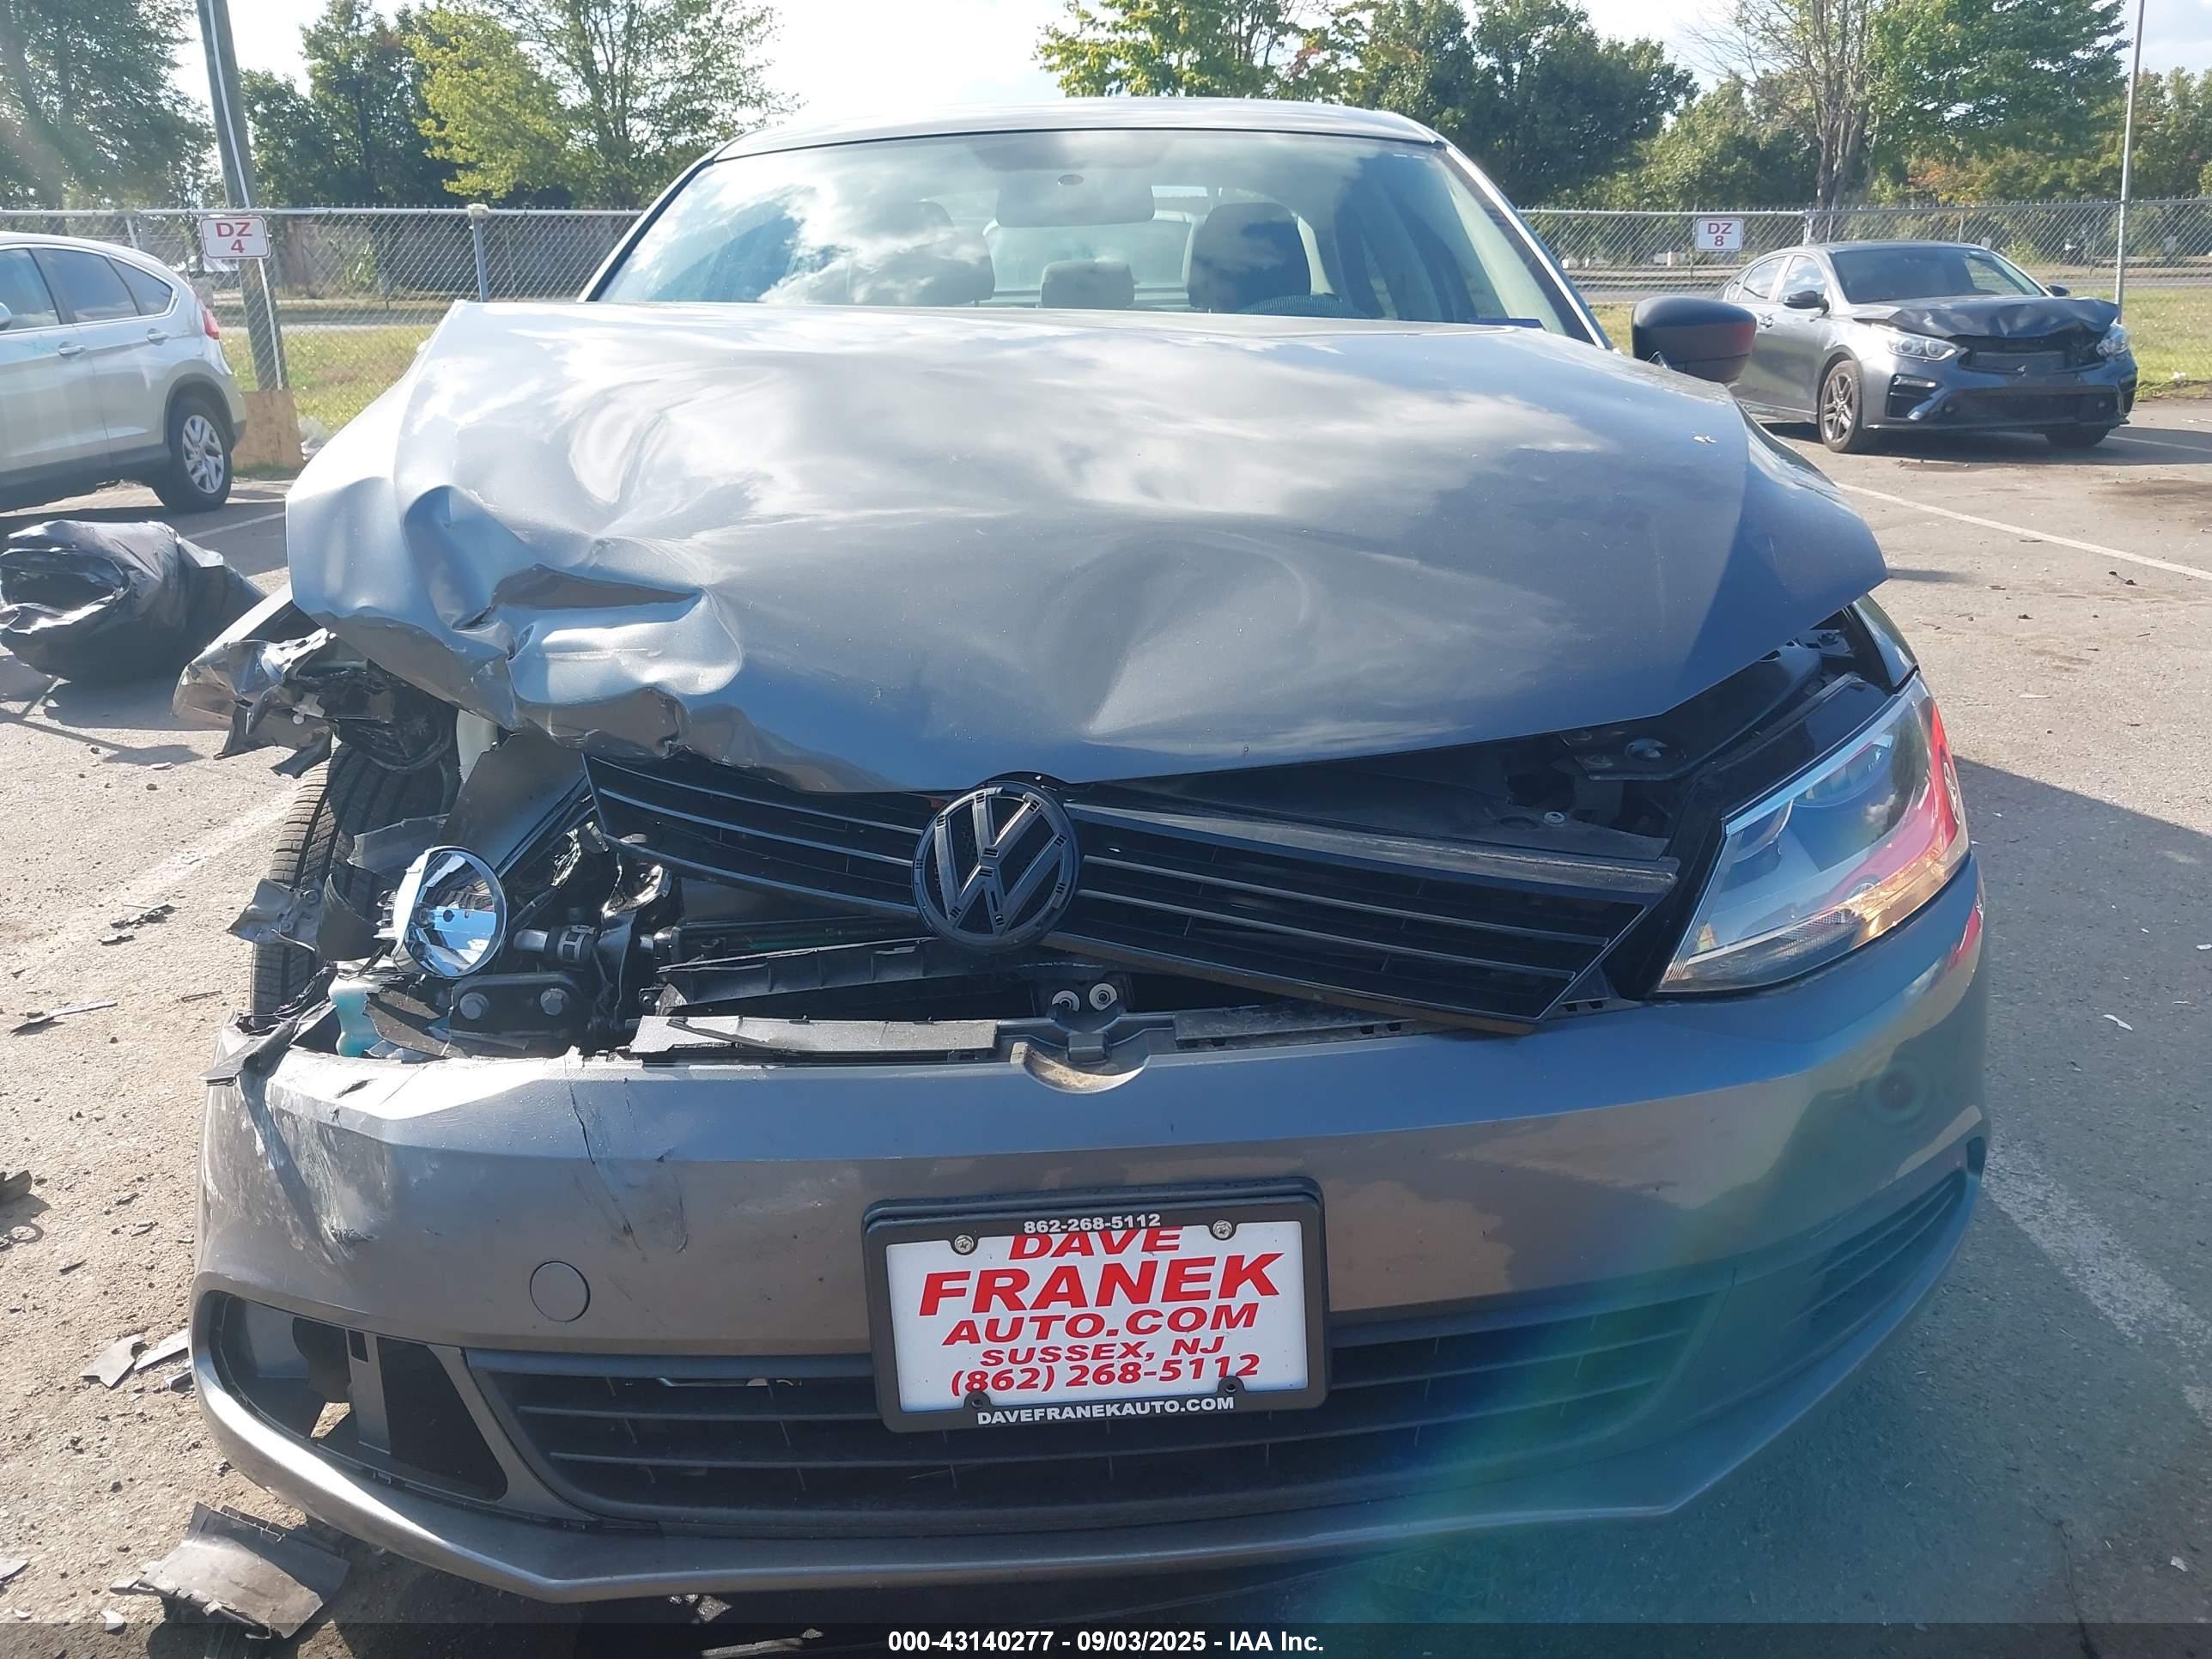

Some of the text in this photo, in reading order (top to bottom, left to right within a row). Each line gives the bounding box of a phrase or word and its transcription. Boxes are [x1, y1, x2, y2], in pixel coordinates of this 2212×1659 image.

[216, 222, 252, 237] DZ
[1707, 222, 1733, 234] DZ
[1714, 235, 1724, 246] 8
[230, 239, 245, 253] 4
[1024, 1212, 1161, 1234] 862-268-5112
[1008, 1225, 1183, 1261] DAVE
[919, 1252, 1285, 1316] FRANEK
[941, 1303, 1259, 1346] AUTO.COM
[980, 1336, 1224, 1366] SUSSEX, NJ
[951, 1353, 1261, 1397] (862) 268-5112
[977, 1397, 1235, 1425] DAVEFRANEKAUTO.COM
